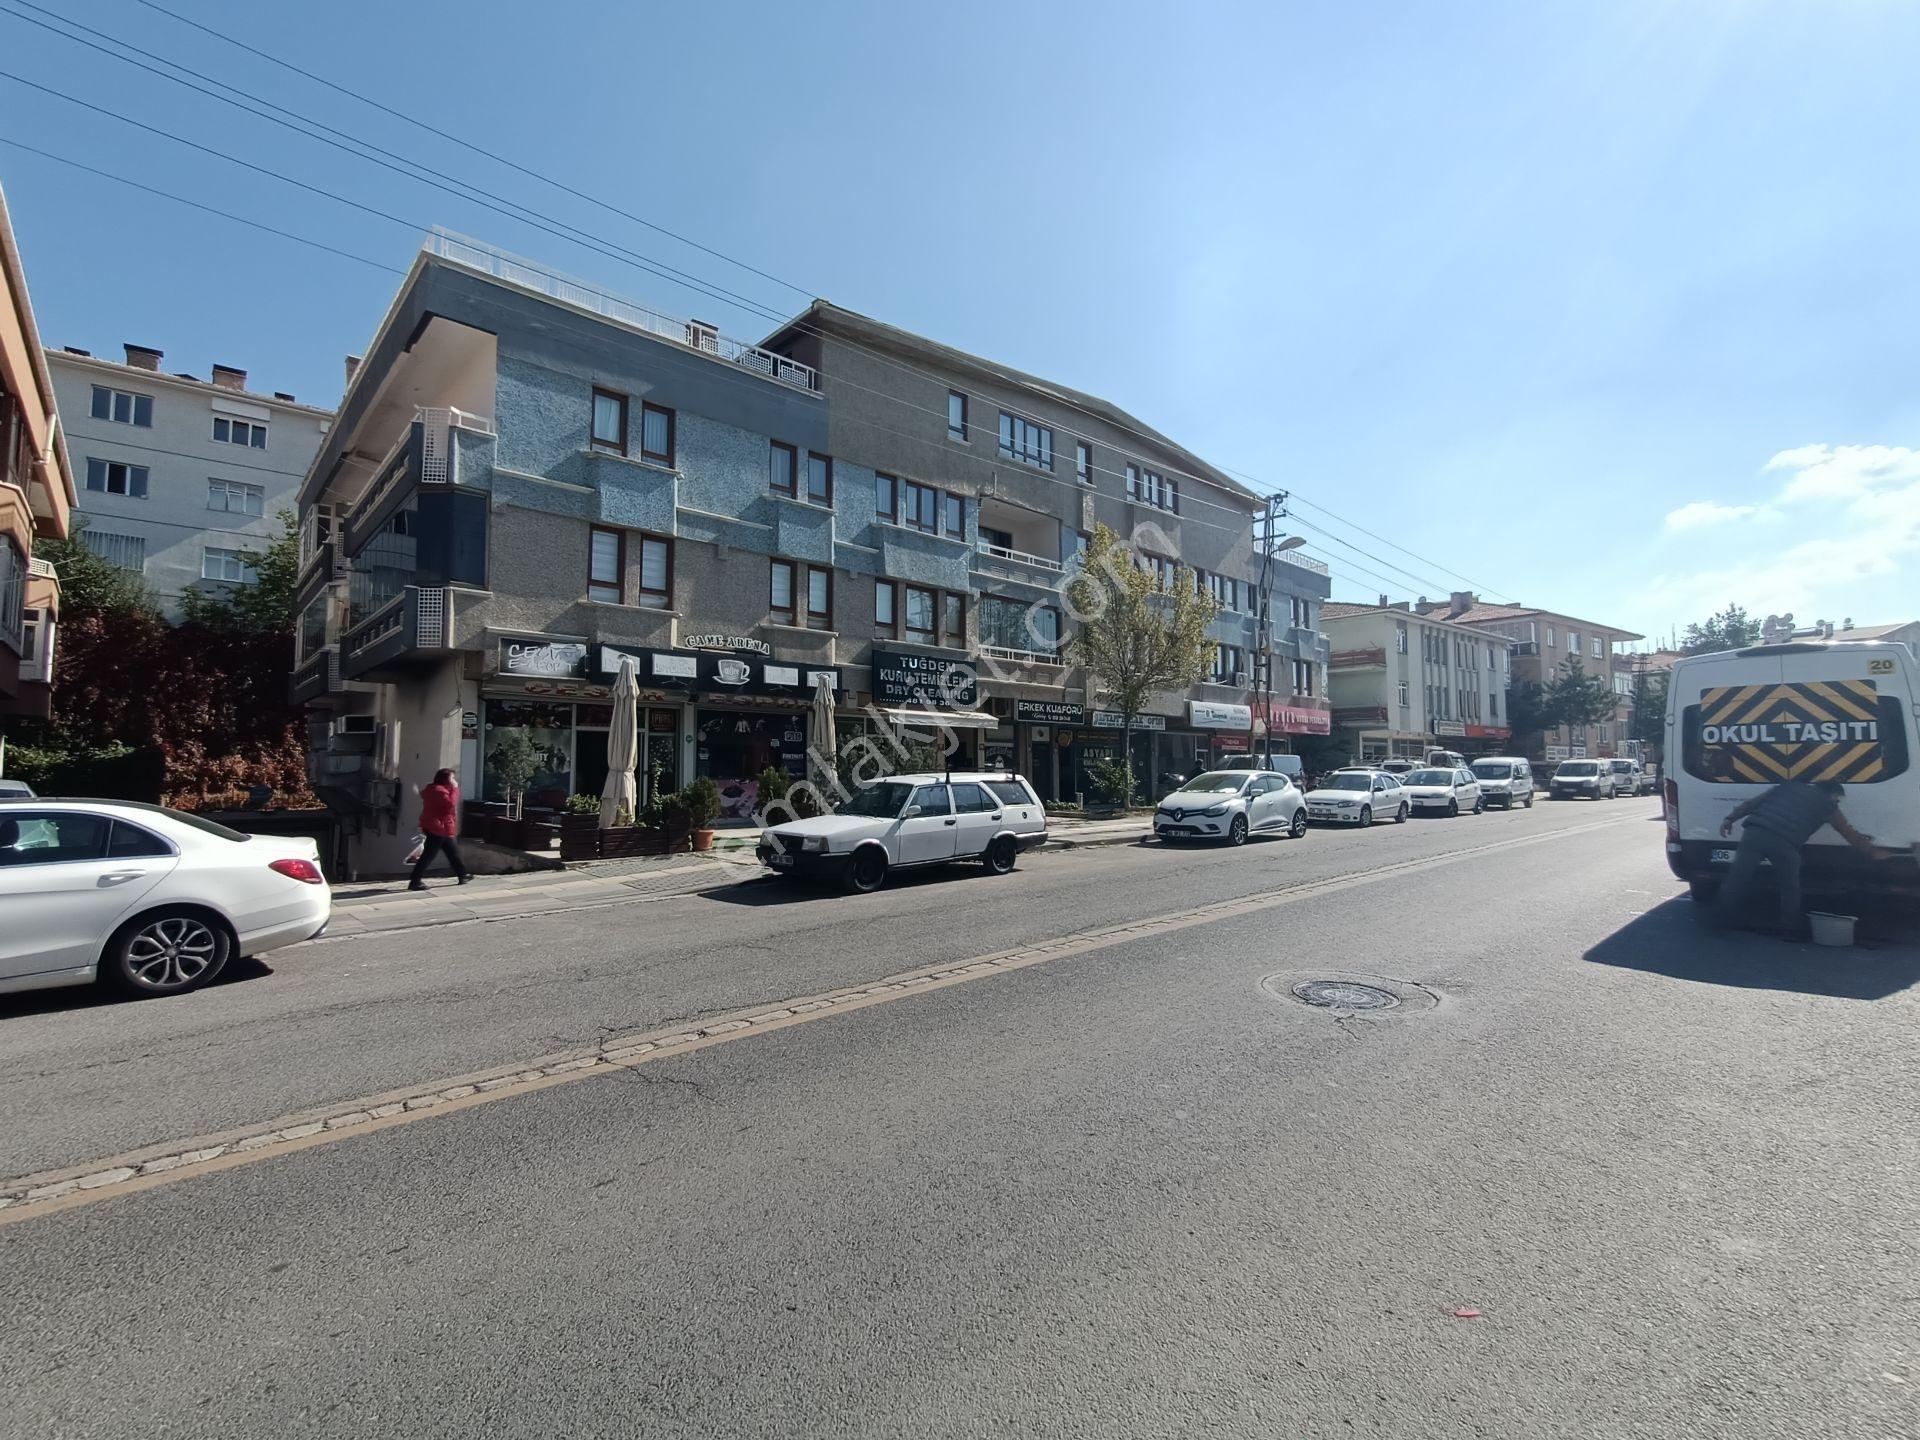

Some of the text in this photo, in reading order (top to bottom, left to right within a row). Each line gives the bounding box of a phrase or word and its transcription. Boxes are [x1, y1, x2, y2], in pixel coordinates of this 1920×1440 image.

[685, 634, 770, 655] GAME ARENA
[900, 657, 956, 672] TUĞDEM
[1870, 660, 1893, 670] 20
[880, 668, 911, 683] KURU
[886, 684, 969, 700] DRY CLEANING
[1019, 702, 1083, 715] ERKEK KUAFÖRÜ
[1702, 721, 1878, 745] OKUL TAŞITI
